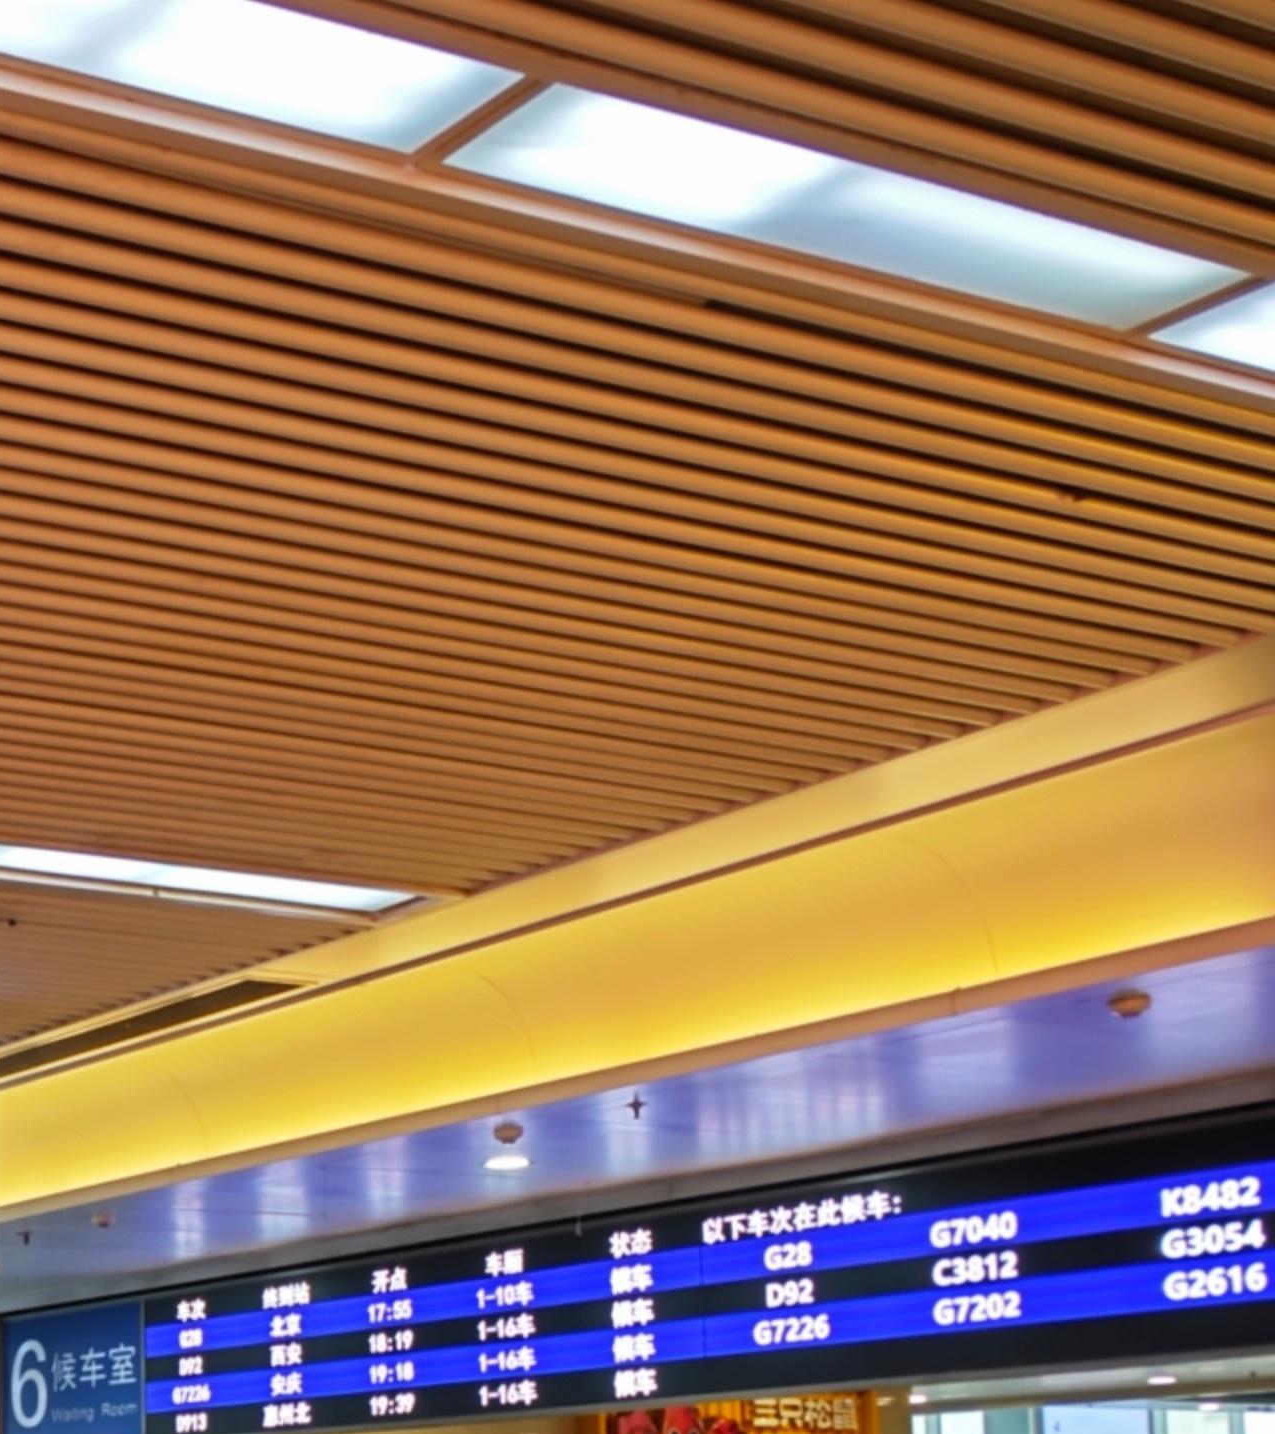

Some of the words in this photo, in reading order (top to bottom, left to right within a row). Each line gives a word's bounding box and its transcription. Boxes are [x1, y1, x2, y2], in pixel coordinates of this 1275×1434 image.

[1160, 1176, 1262, 1219] K8482
[608, 1227, 653, 1259] 状态
[929, 1211, 1018, 1250] G7040
[1161, 1219, 1267, 1260] G3054
[764, 1241, 812, 1271] G28
[932, 1251, 1018, 1288] C3812
[370, 1267, 408, 1294] 开点
[610, 1263, 654, 1296] 候车
[766, 1279, 814, 1308] D92
[1163, 1262, 1268, 1301] G2616
[176, 1298, 207, 1323] 车次
[367, 1299, 413, 1323] 17:55
[611, 1298, 655, 1329] 候车
[933, 1290, 1022, 1325] G7202
[269, 1313, 302, 1338] 北京
[368, 1329, 414, 1354] 18:19
[753, 1314, 831, 1346] G7226
[269, 1342, 303, 1367] 西安
[612, 1332, 656, 1364] 候车
[11, 1339, 47, 1428] 6
[51, 1342, 137, 1393] 候车室
[613, 1367, 658, 1399] 候车
[270, 1371, 303, 1397] 安庆
[102, 1403, 138, 1417] Room
[369, 1393, 415, 1416] 19:39
[753, 1397, 857, 1430] 三只松鼠
